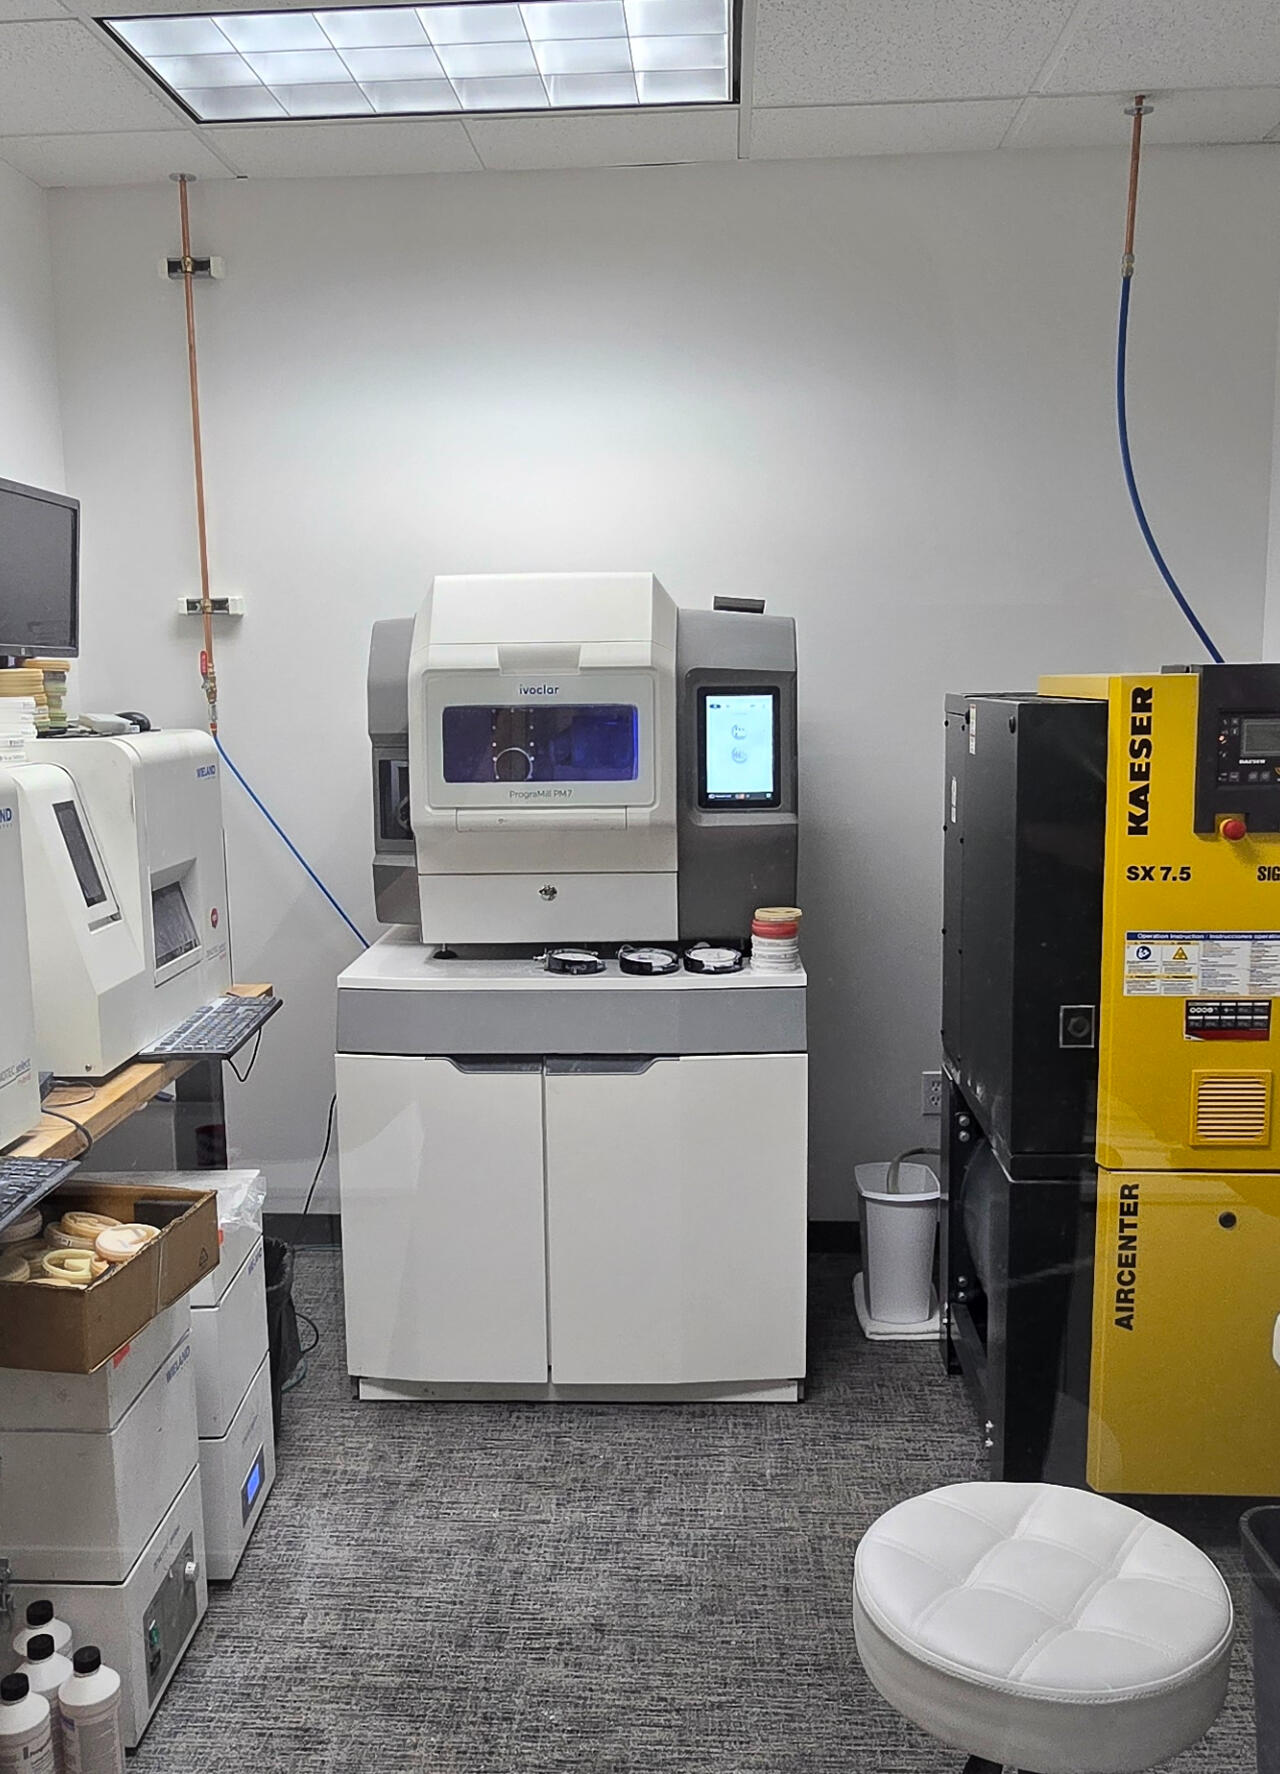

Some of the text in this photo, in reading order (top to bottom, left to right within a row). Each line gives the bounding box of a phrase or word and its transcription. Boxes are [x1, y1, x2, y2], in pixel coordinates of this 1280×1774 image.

[519, 684, 559, 695] ivoclar
[1128, 686, 1153, 835] KAESER
[1126, 865, 1192, 882] SX 7.5
[1114, 1183, 1140, 1331] AIRCENTER
